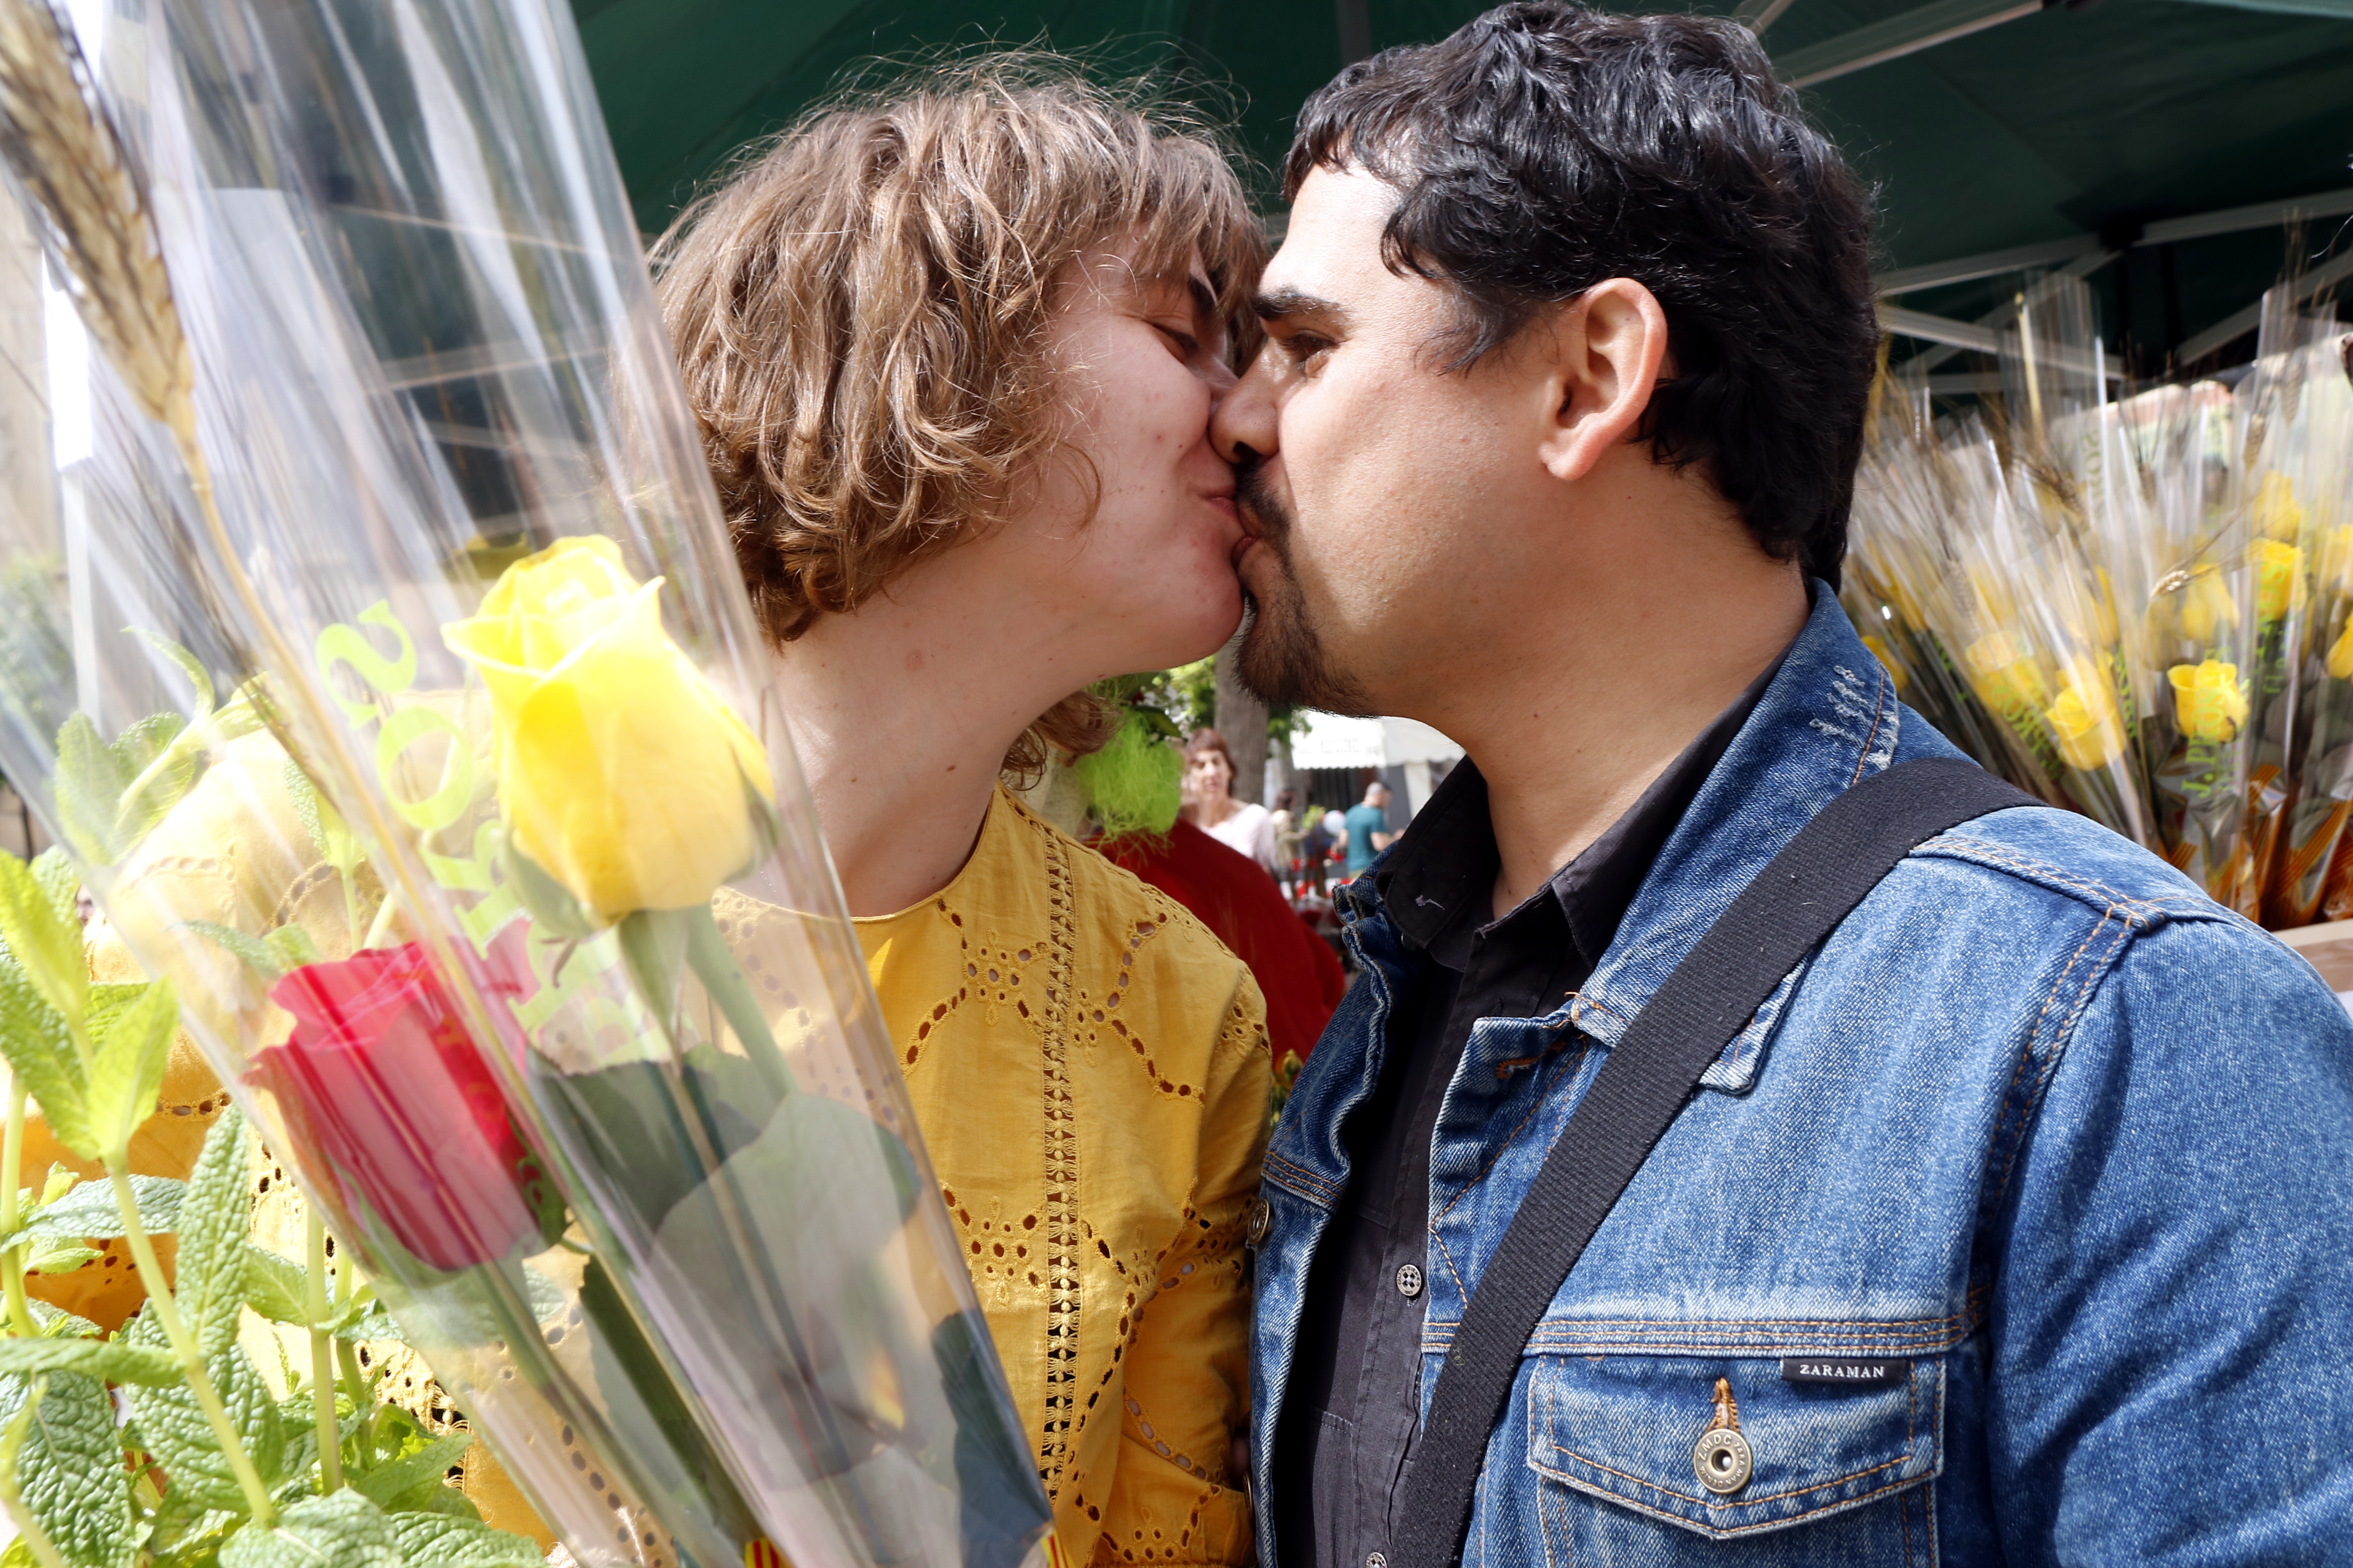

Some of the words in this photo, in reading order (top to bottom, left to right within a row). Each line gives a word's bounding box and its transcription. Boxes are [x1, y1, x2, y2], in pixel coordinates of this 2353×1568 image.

[2185, 688, 2226, 765] PROS
[1800, 1364, 1885, 1379] ZARAMAN
[1698, 1434, 1731, 1461] ZMDC
[1725, 1468, 1744, 1485] MAN
